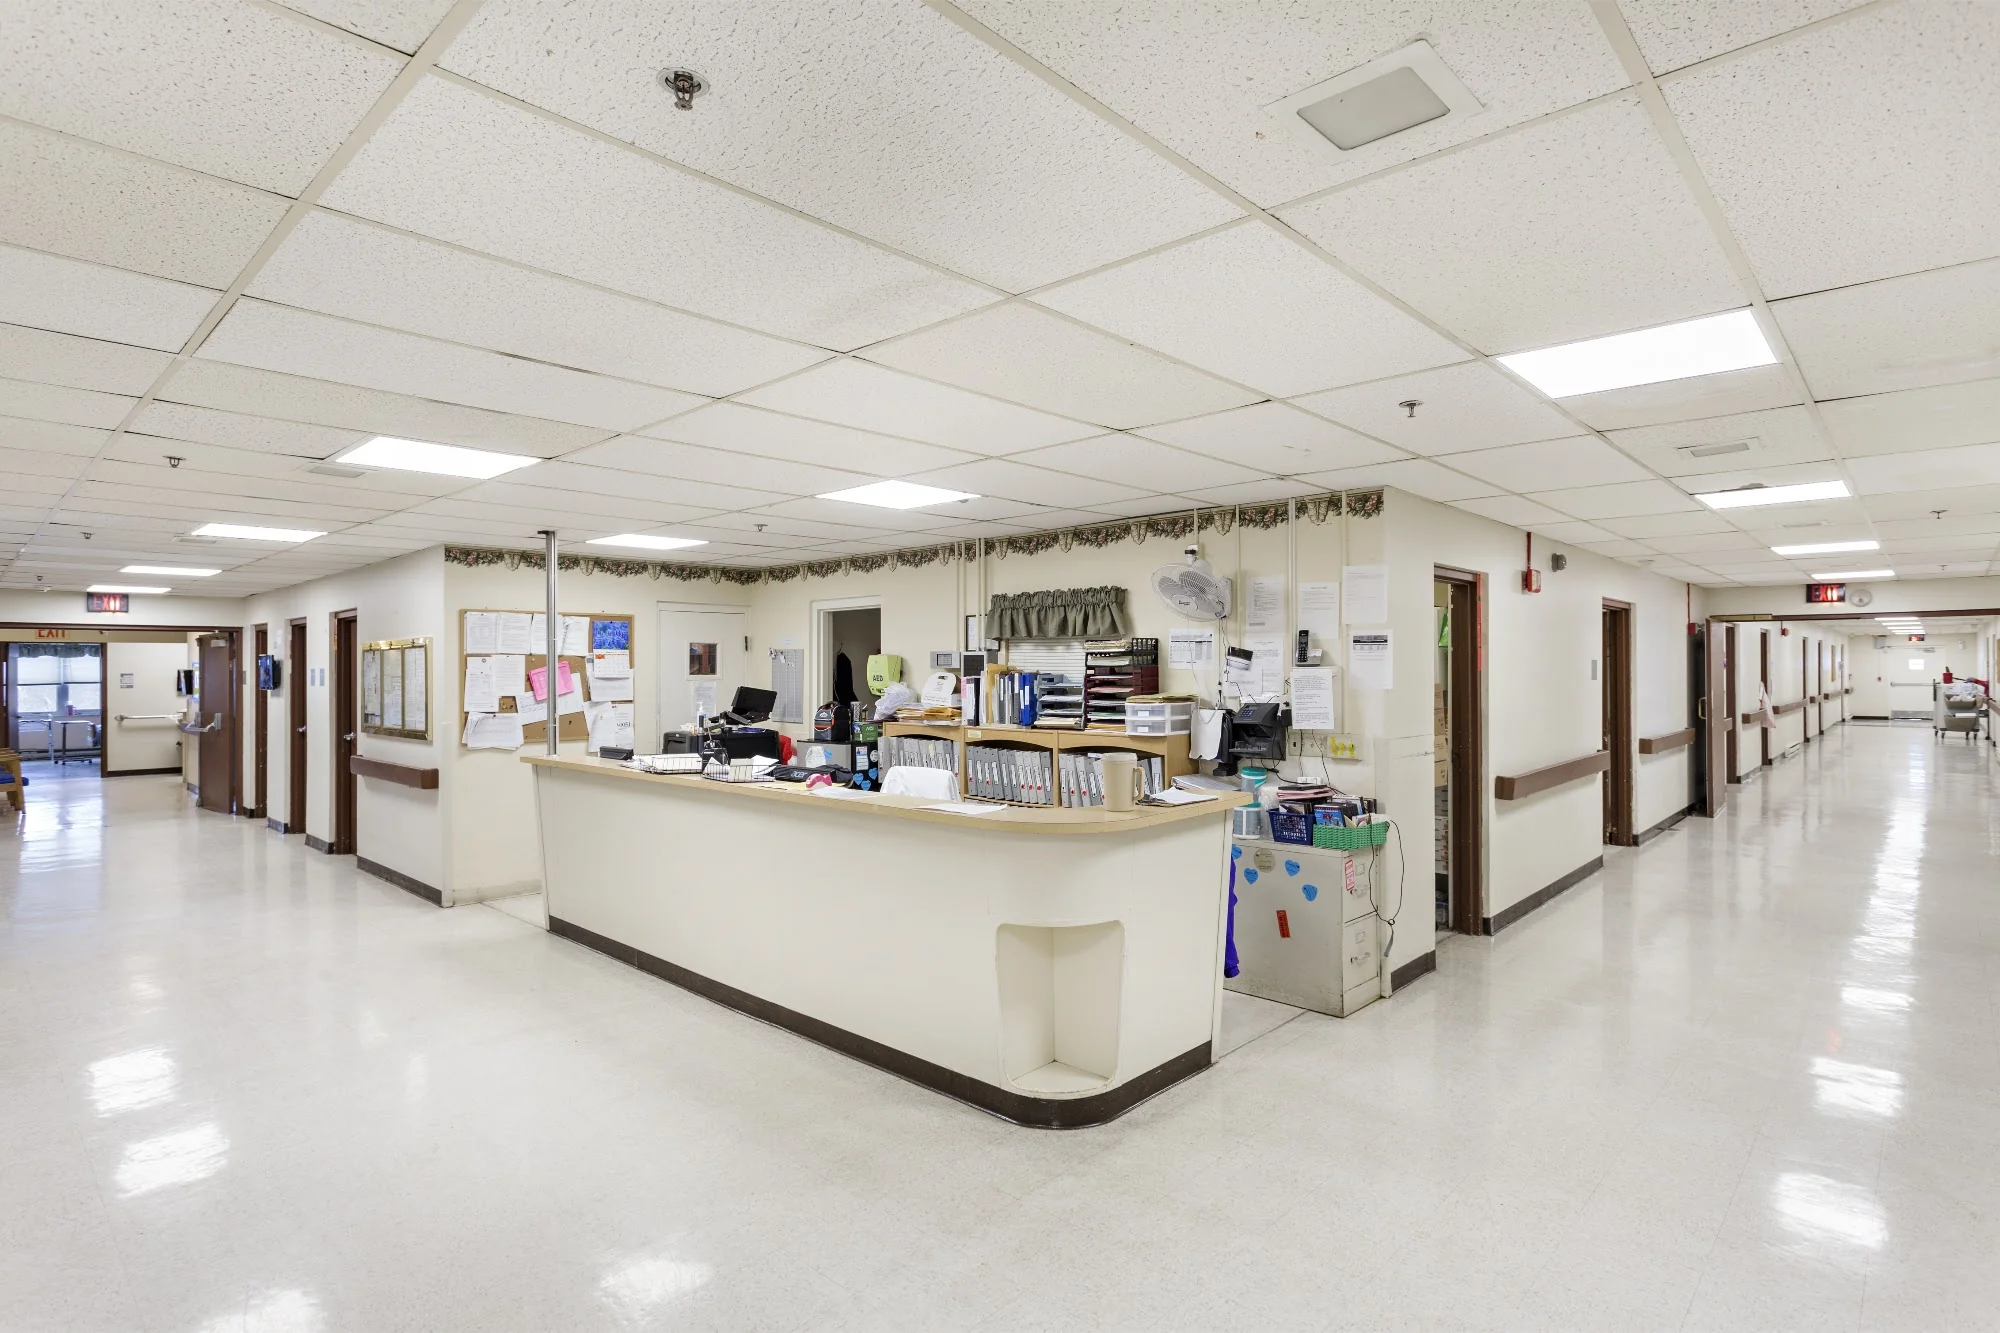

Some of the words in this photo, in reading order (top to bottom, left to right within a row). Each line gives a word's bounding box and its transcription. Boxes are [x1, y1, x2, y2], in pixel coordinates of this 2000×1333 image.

[1811, 584, 1839, 601] EXIT
[92, 594, 122, 610] EXIT
[38, 629, 65, 638] EXIT
[872, 674, 884, 682] AED
[790, 770, 808, 778] acer
